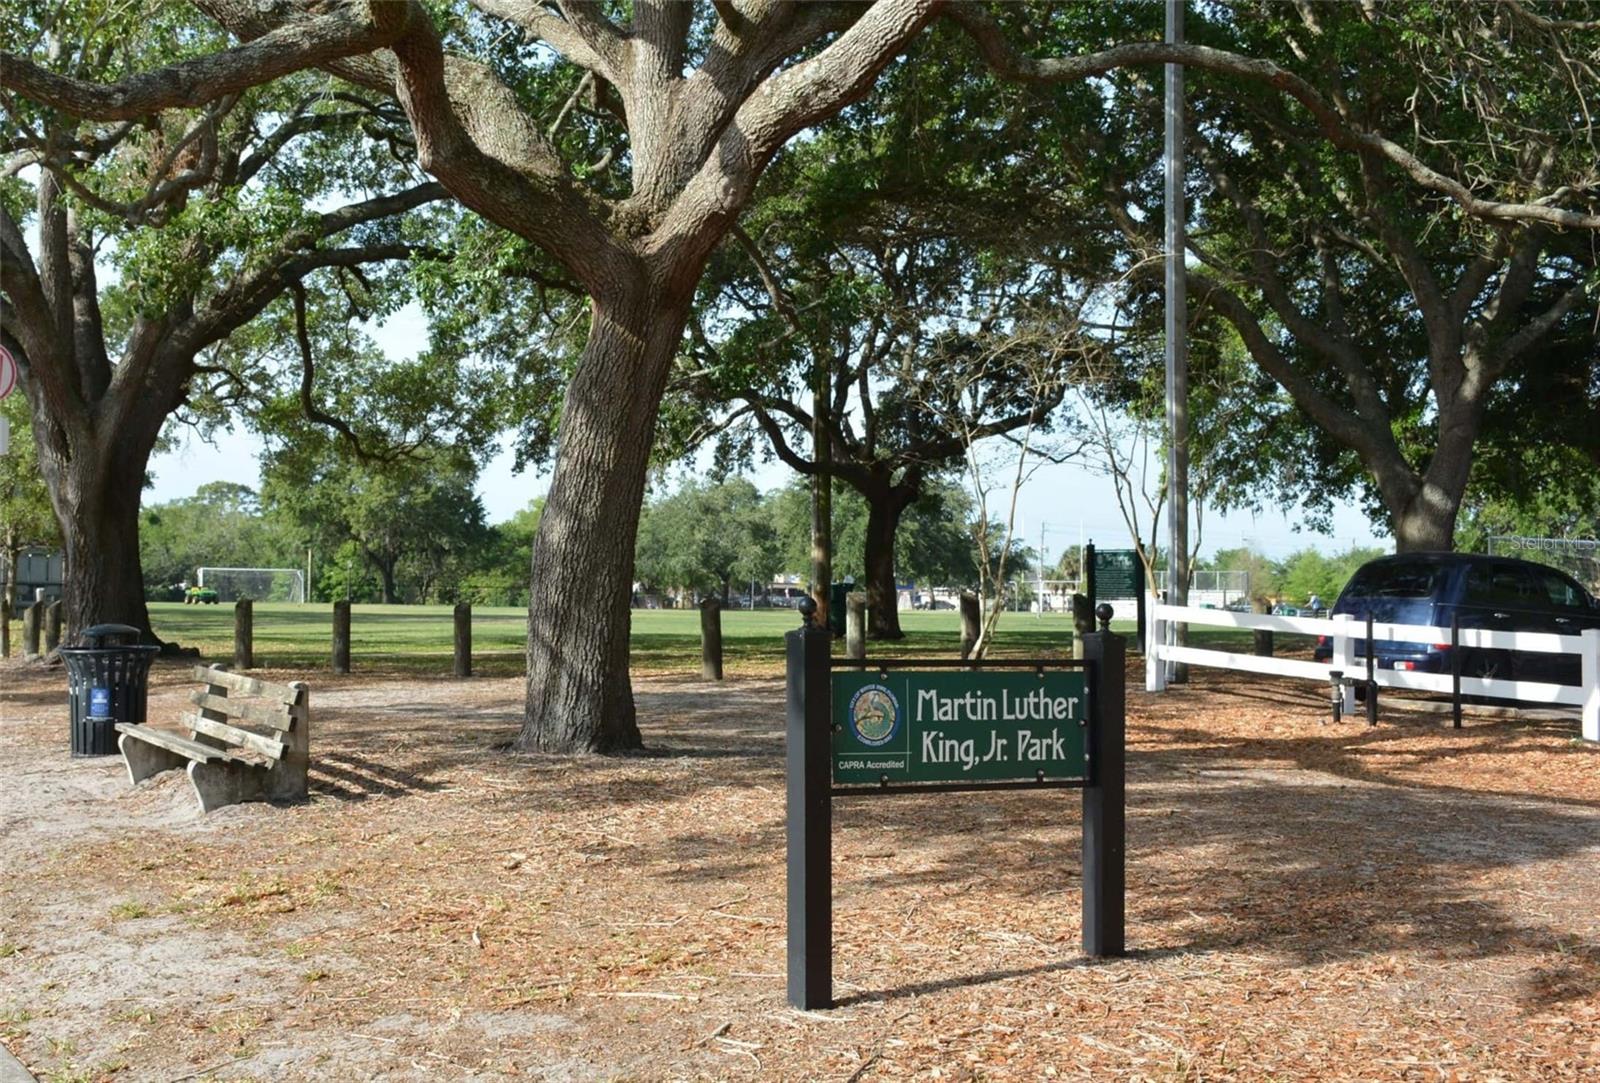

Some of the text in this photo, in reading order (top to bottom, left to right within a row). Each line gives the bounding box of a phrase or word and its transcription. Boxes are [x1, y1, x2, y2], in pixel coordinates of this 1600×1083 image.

[916, 688, 997, 722] Martin
[1002, 687, 1079, 720] Luther
[838, 760, 905, 770] CAPRA Accredited
[921, 730, 981, 771] King,
[983, 730, 1008, 762] Jr.
[1017, 727, 1066, 761] Park
